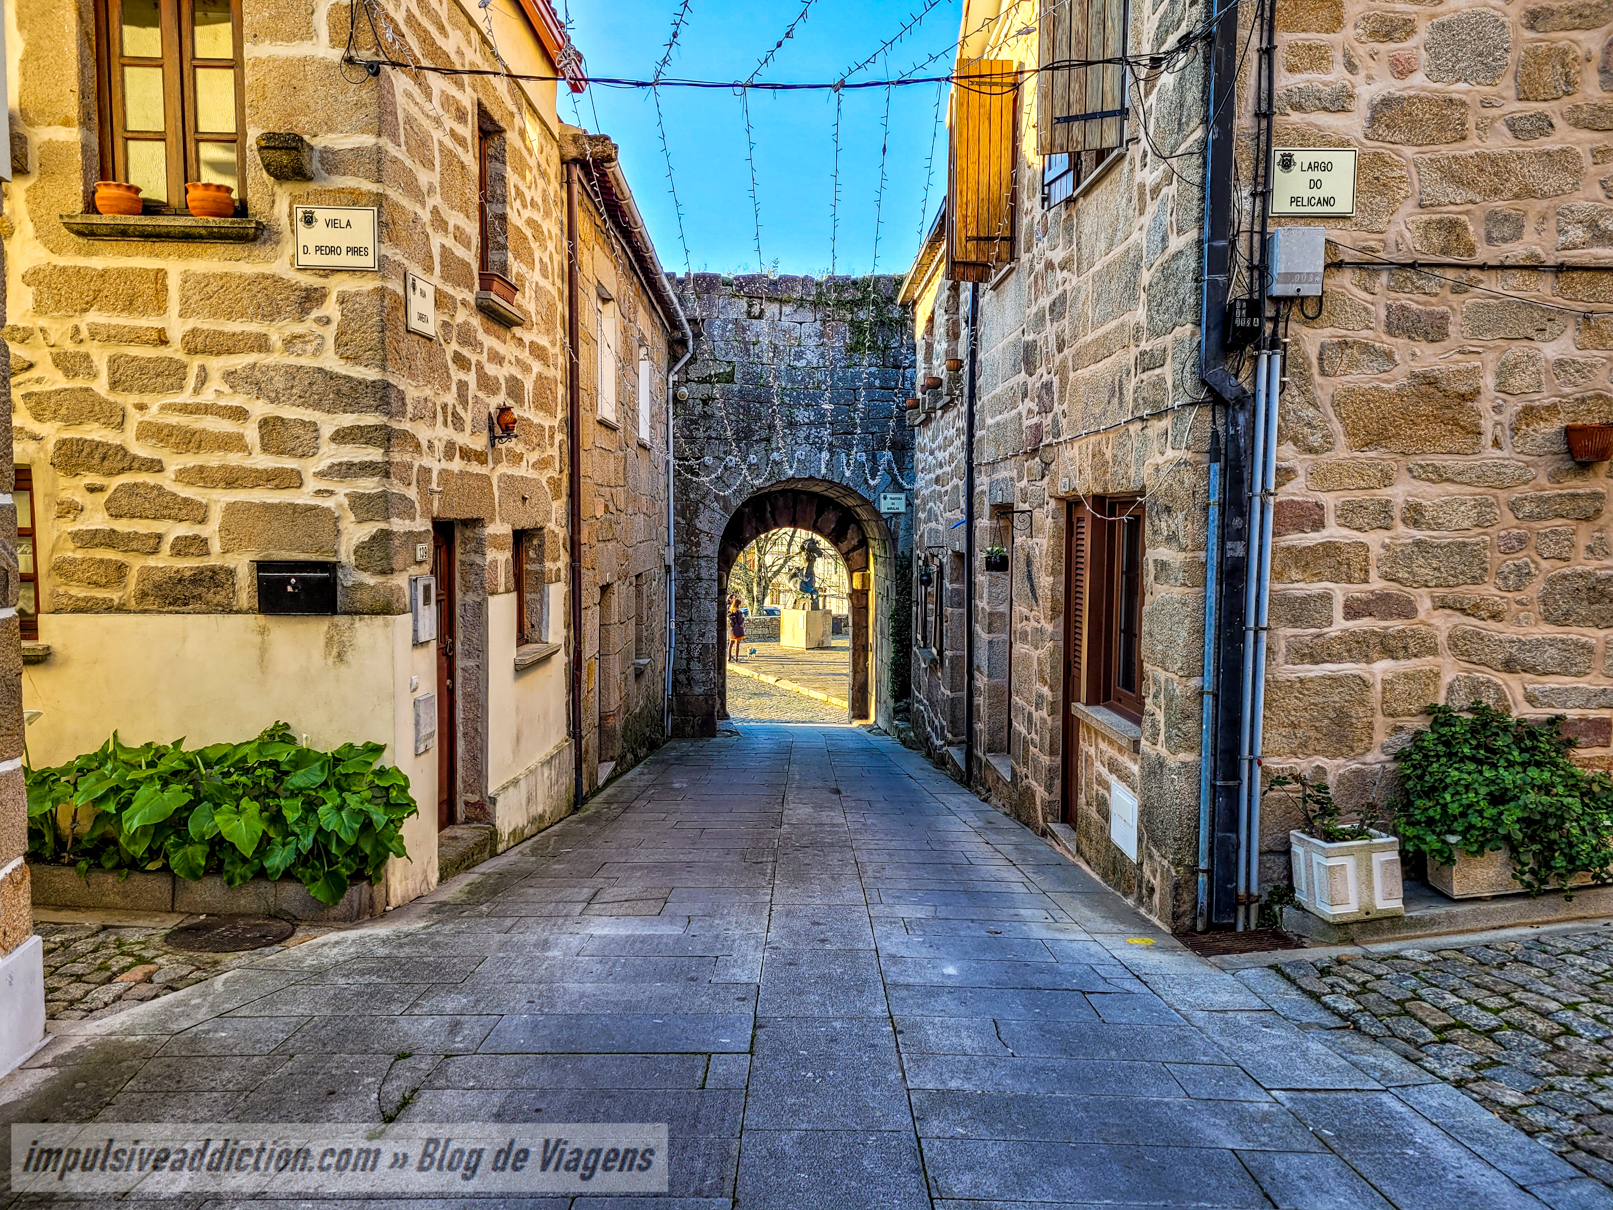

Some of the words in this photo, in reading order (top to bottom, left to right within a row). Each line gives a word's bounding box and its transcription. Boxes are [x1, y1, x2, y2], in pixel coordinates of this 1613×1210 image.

[1300, 161, 1333, 172] LARGO
[1309, 178, 1322, 190] DO
[1290, 196, 1336, 207] PELICANO
[324, 218, 352, 229] VIELA
[302, 245, 311, 255] D.
[314, 245, 342, 256] PEDRO
[346, 246, 369, 257] PIRES
